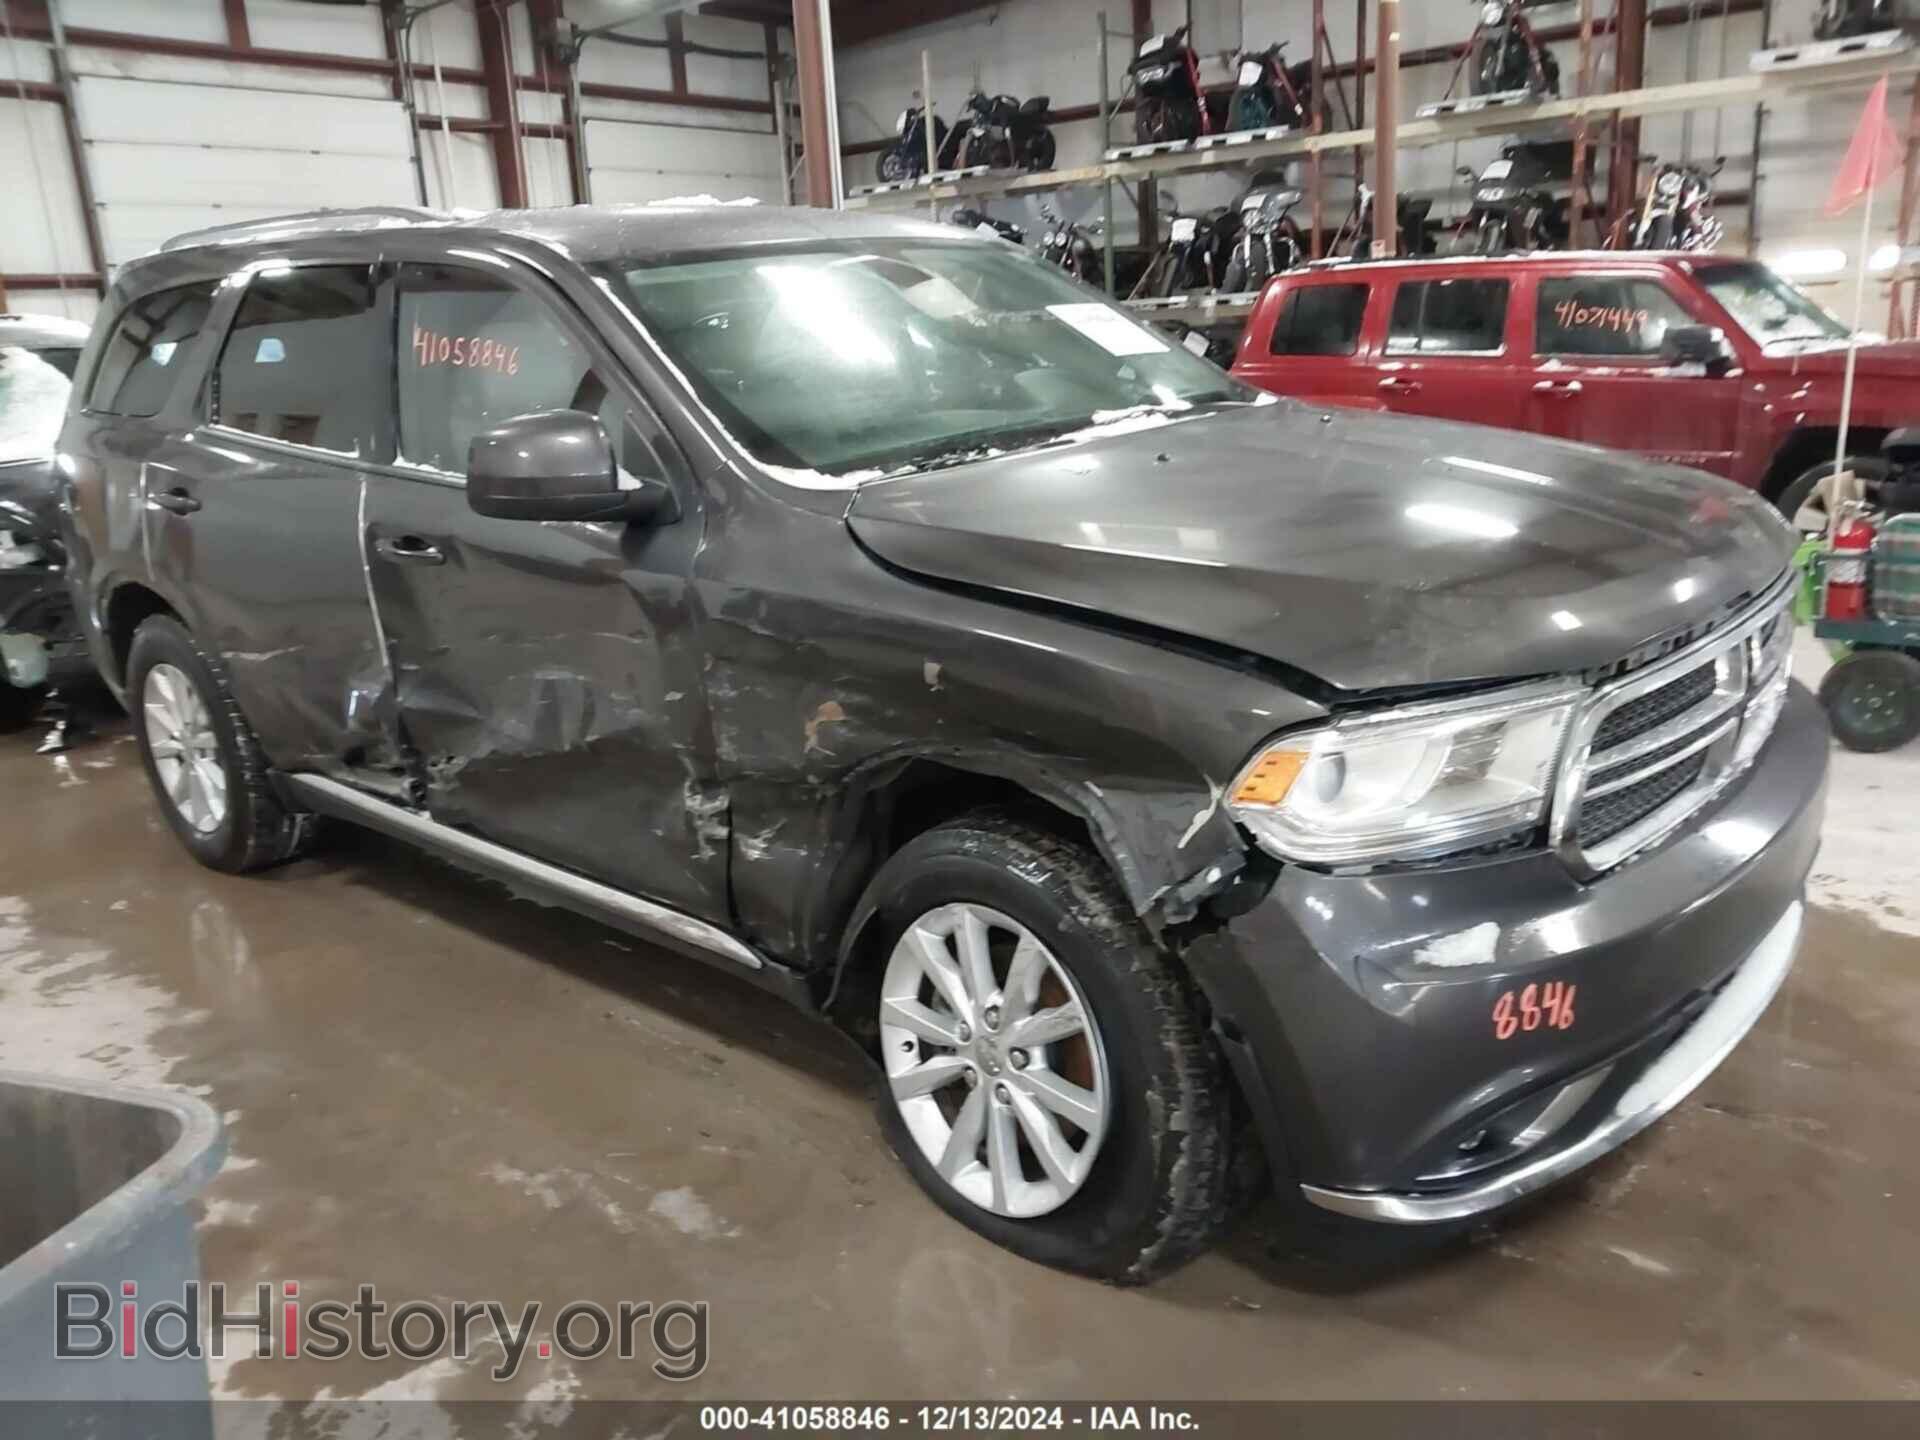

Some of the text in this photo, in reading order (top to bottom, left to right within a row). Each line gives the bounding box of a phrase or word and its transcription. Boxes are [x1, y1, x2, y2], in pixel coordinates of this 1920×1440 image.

[1555, 301, 1648, 333] 41071449
[412, 322, 520, 375] 41058846
[1492, 981, 1576, 1040] 8846
